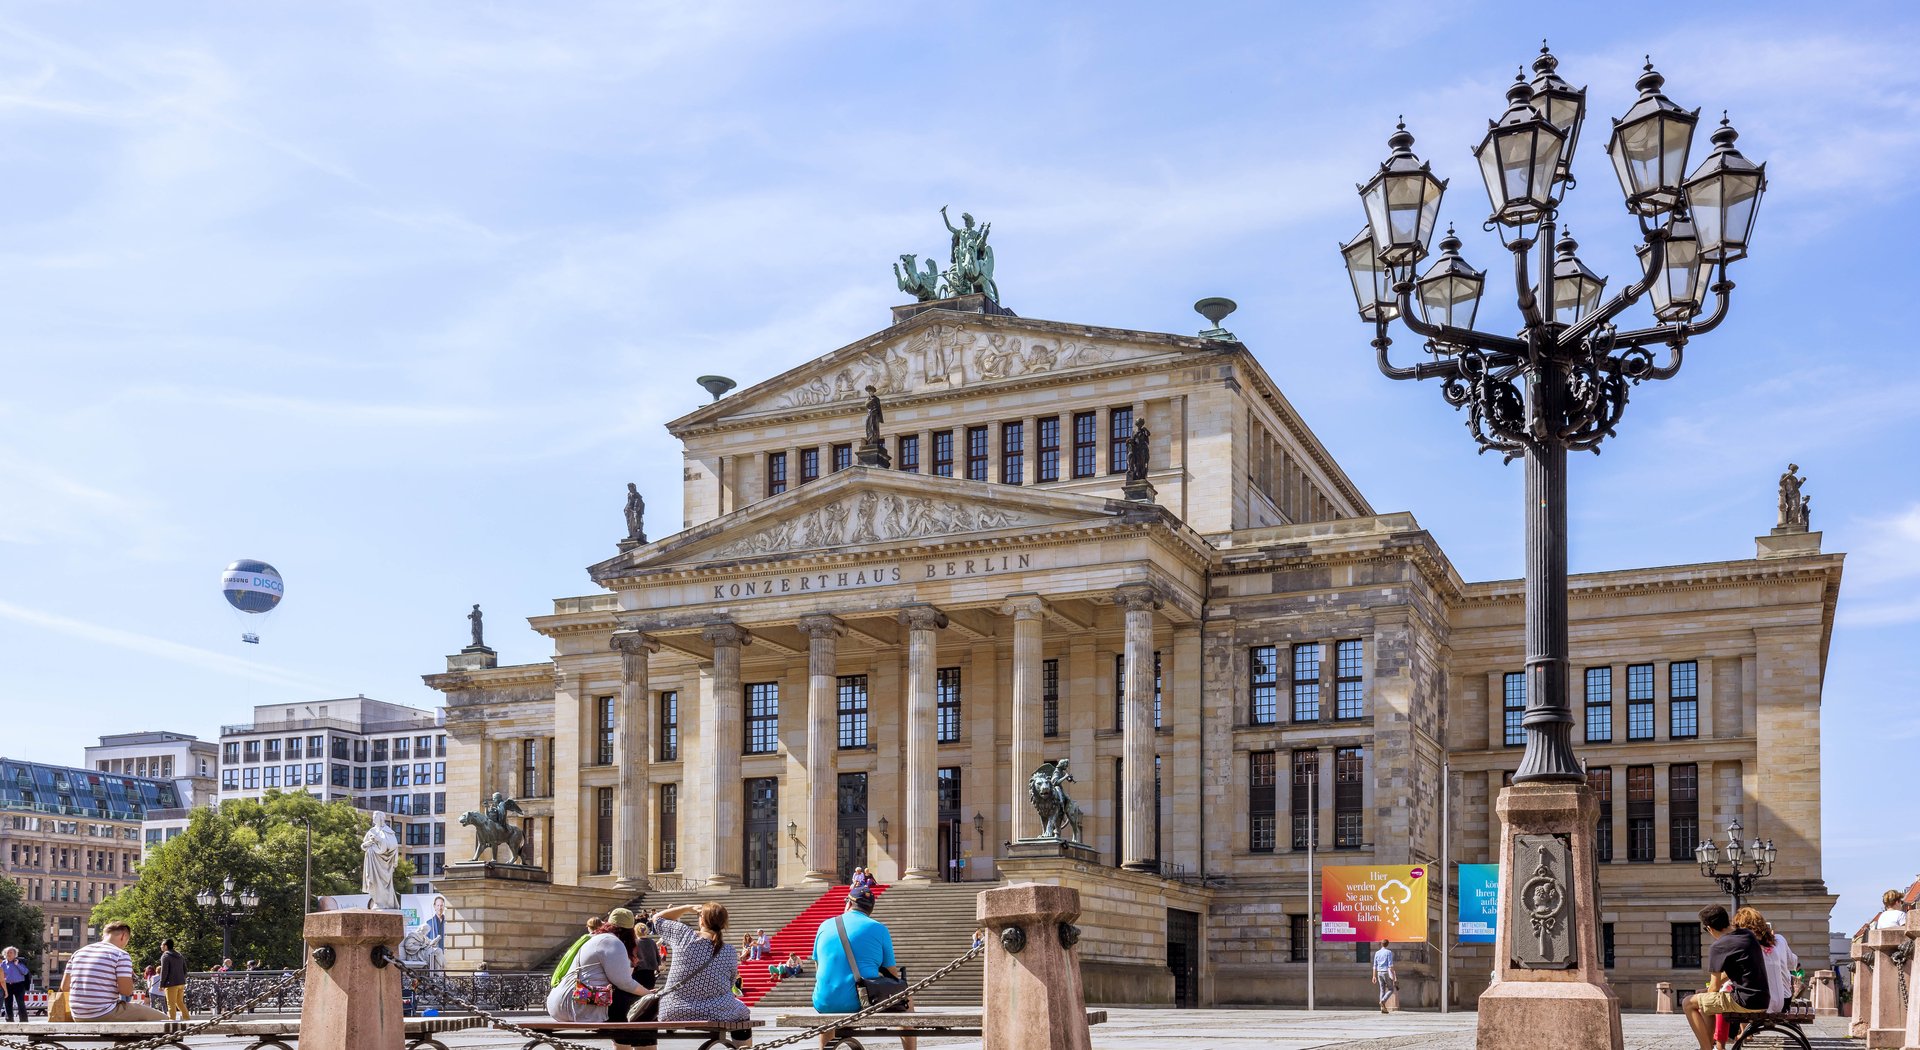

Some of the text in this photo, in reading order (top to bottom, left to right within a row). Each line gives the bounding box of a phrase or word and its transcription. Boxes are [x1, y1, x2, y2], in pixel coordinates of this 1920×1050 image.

[714, 554, 1030, 598] KONZERTHAUS BERLIN
[1370, 871, 1388, 881] Hier
[1346, 882, 1376, 891] werden
[1346, 892, 1358, 901] Sie
[1476, 889, 1495, 897] Ihren
[1333, 902, 1382, 911] allen Clouds
[1357, 912, 1382, 922] fallen.
